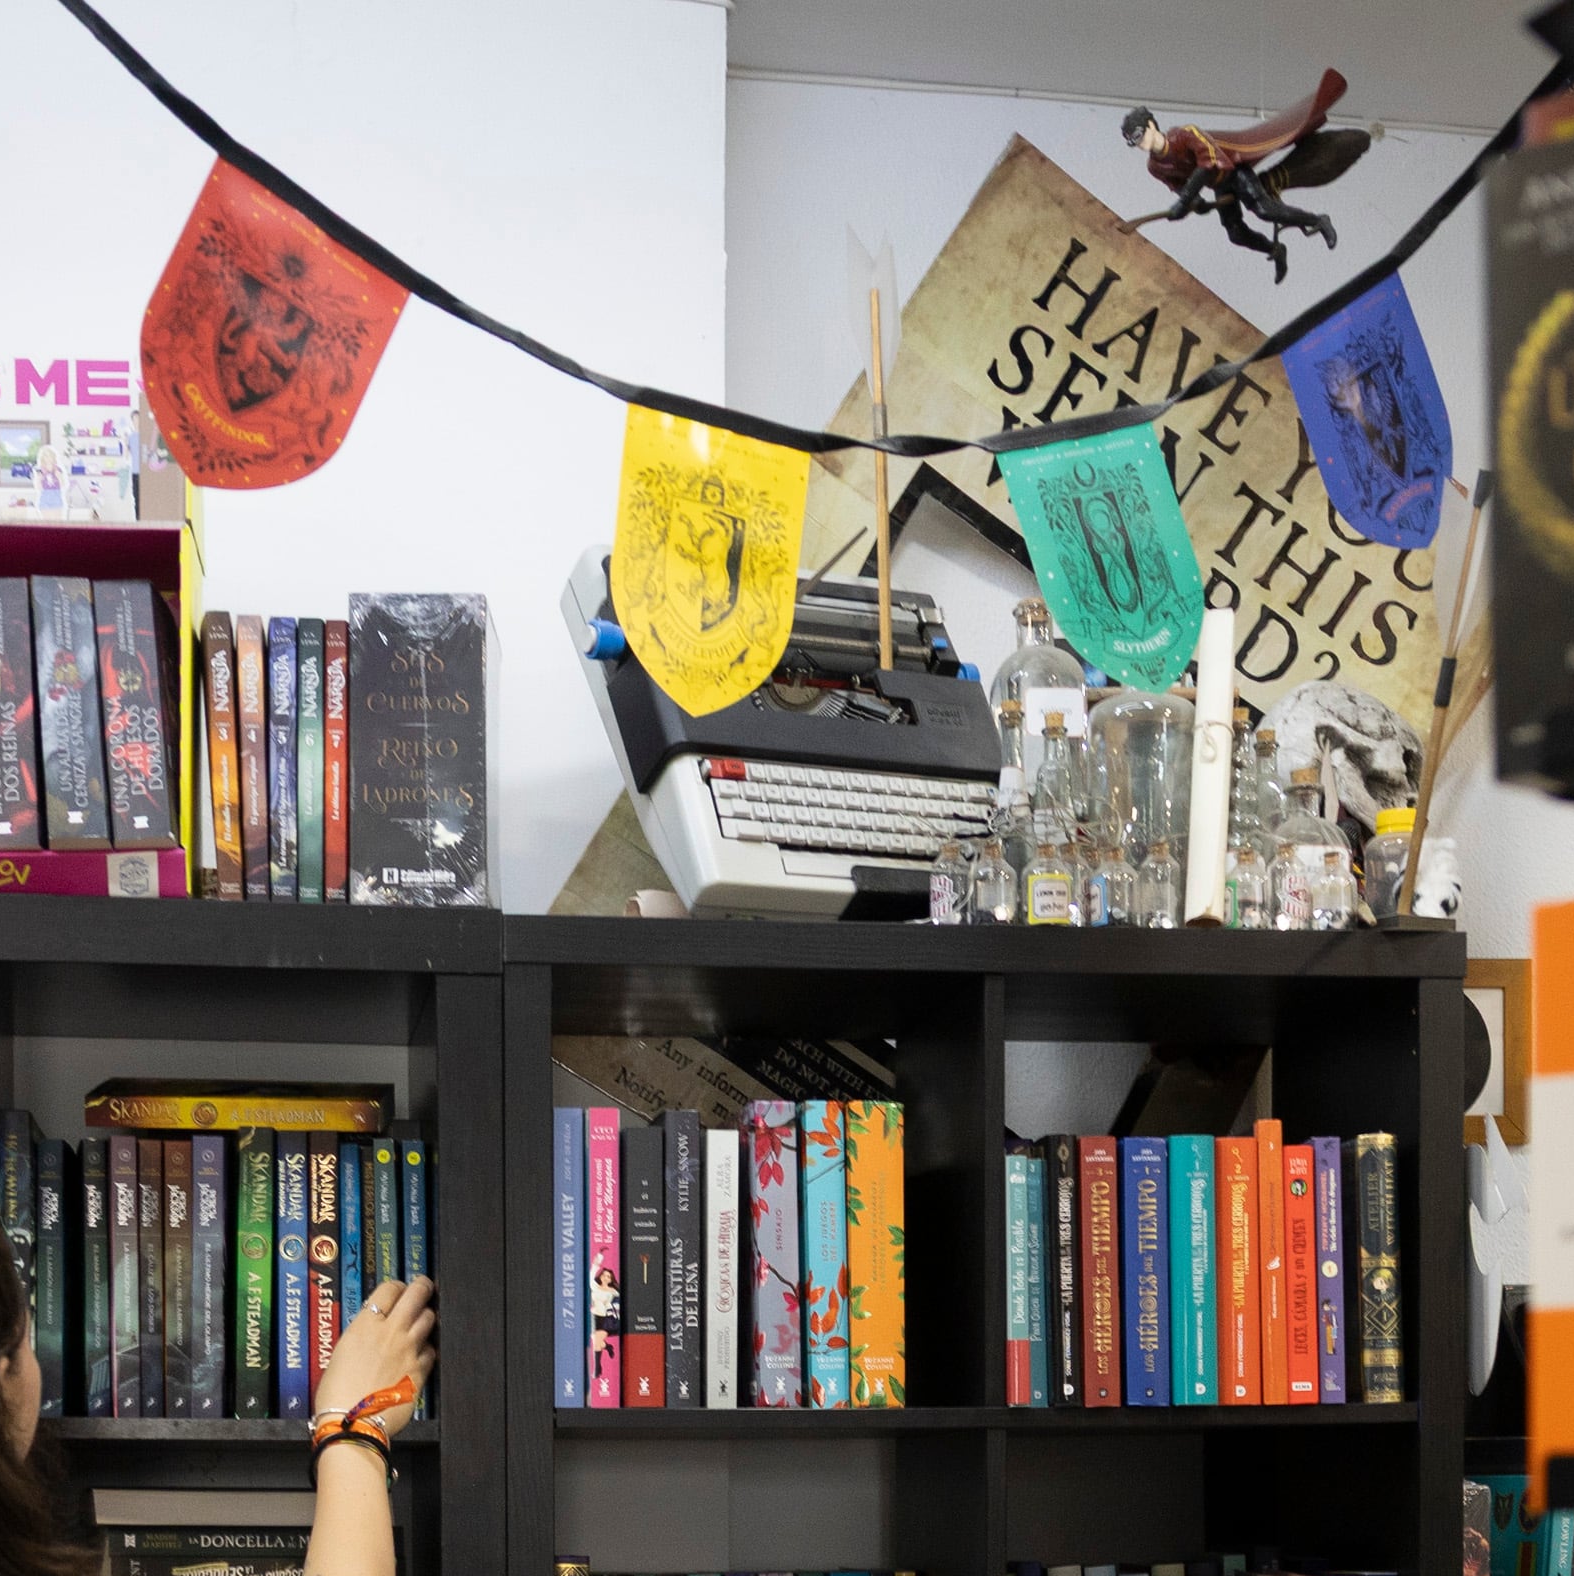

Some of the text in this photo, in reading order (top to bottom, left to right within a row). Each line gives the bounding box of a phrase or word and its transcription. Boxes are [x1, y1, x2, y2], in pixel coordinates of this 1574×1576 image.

[15, 359, 131, 407] ME
[1032, 238, 1272, 455] HAVE
[185, 383, 270, 446] GRYFFINDOR
[1215, 481, 1419, 666] THIS
[1112, 628, 1171, 653] SLYTHERIN
[2, 768, 20, 801] DOS
[105, 695, 130, 813] UNA CORONA
[124, 704, 147, 796] DE HUESOS
[142, 707, 164, 791] DORADOS
[655, 1039, 691, 1066] Any
[677, 1132, 690, 1211] KYLIE SNOW
[561, 1193, 576, 1297] RIVER VALLEY
[1090, 1181, 1111, 1256] TIEMPO
[245, 1152, 271, 1368] SKANDAR STEADMAN
[285, 1153, 305, 1369] SKANDAR STEADMAN
[670, 1238, 684, 1350] LAS MENTIRAS
[686, 1262, 699, 1327] DE LENA
[1090, 1276, 1113, 1353] HÉROES
[1097, 1355, 1109, 1374] LOS
[200, 1535, 285, 1549] DONCELLA
